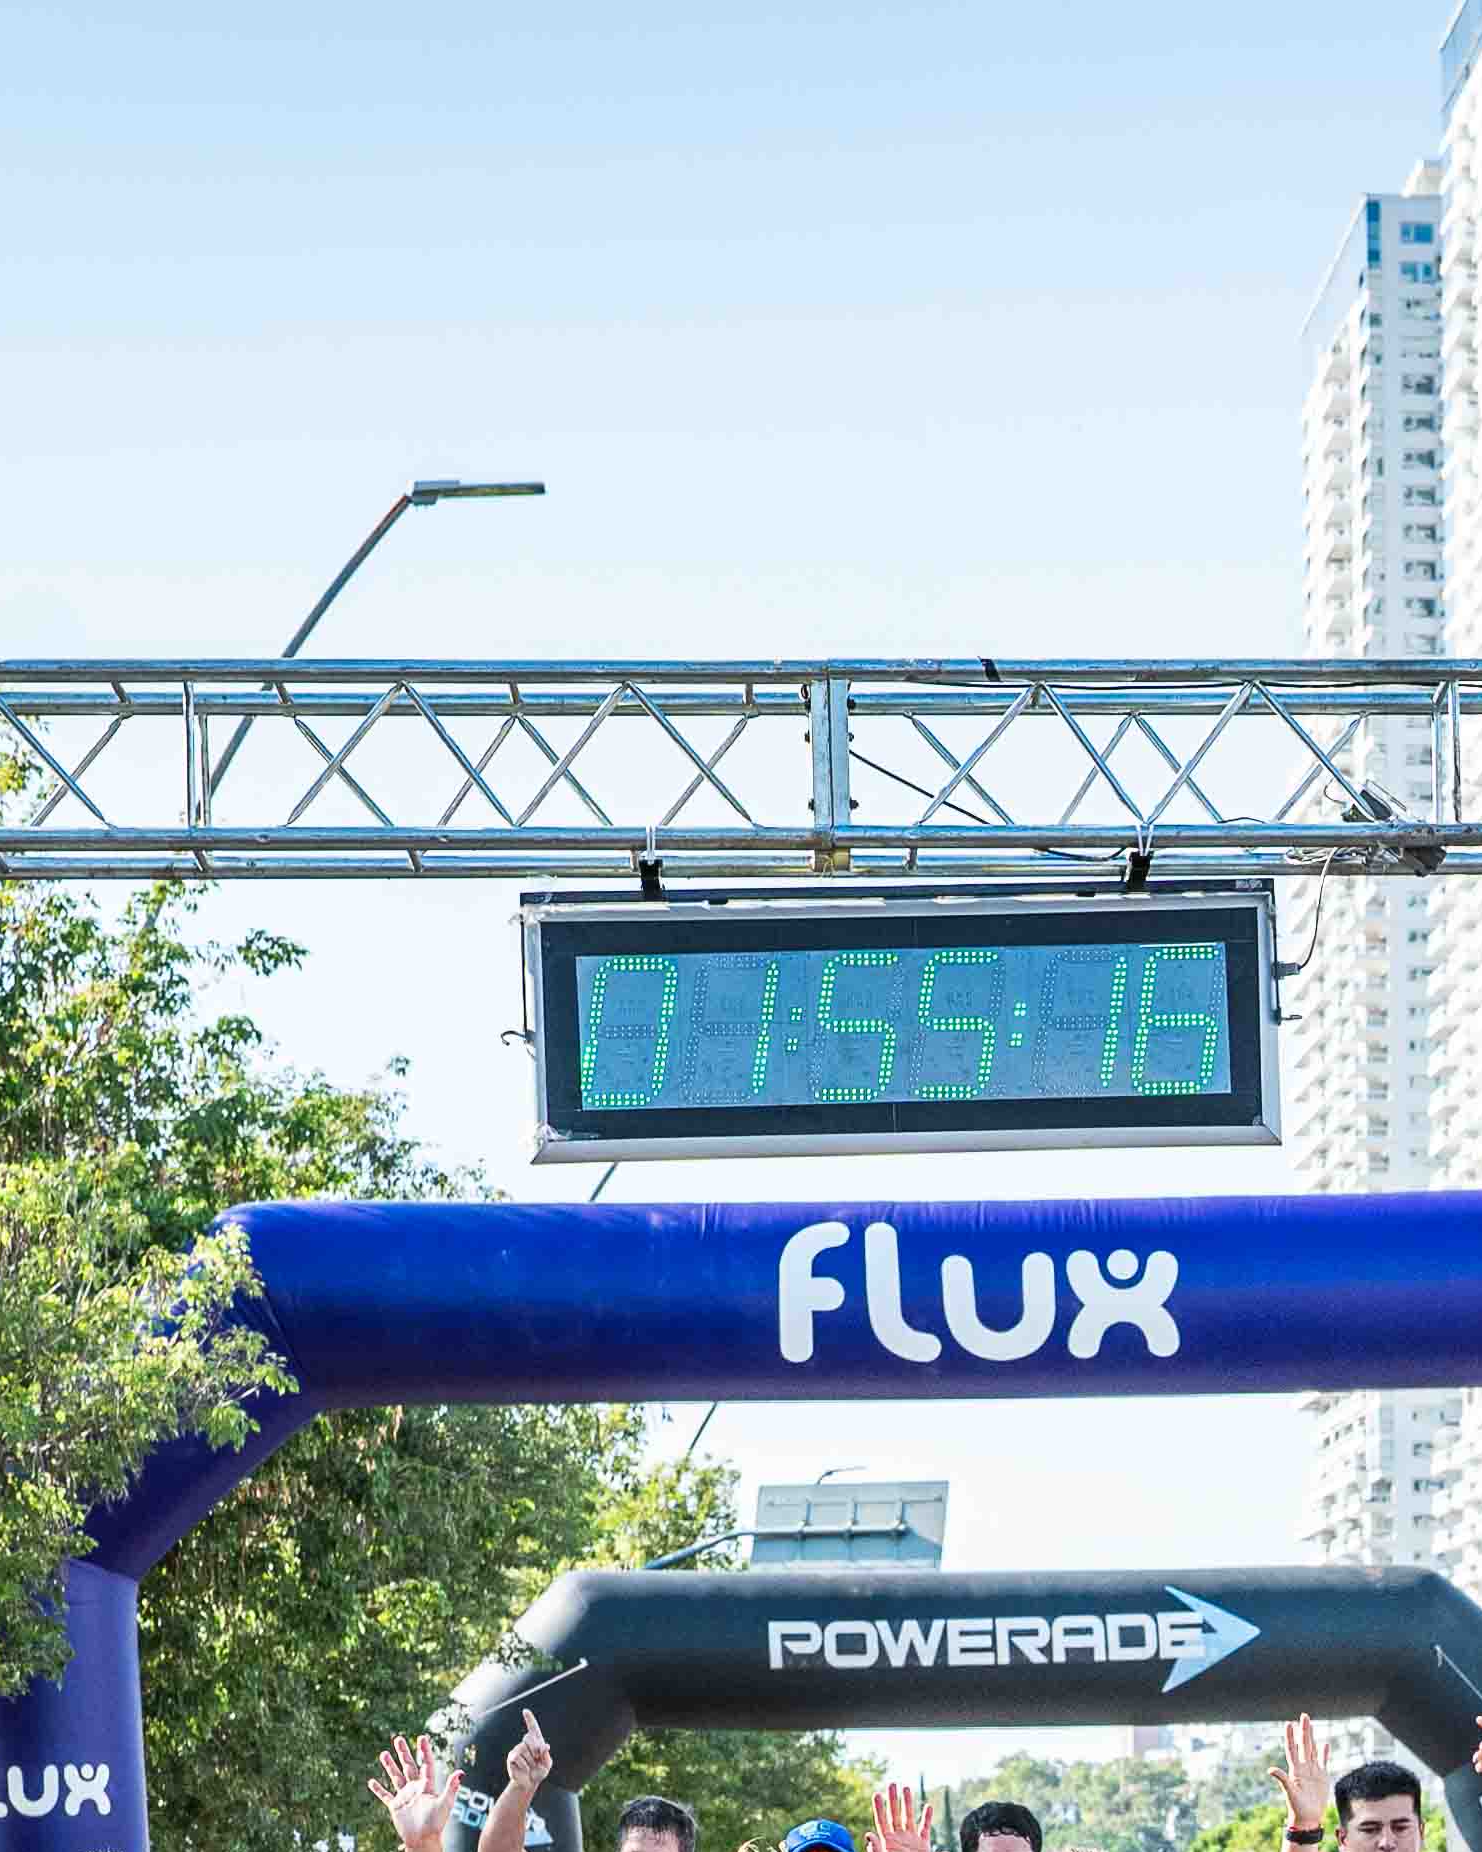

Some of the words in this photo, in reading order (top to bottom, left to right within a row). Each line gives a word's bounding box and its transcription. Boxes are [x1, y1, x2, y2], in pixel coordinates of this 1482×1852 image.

[580, 944, 1219, 1106] 01:55:16
[778, 1220, 1181, 1364] flux
[767, 1610, 1209, 1670] POWERADE
